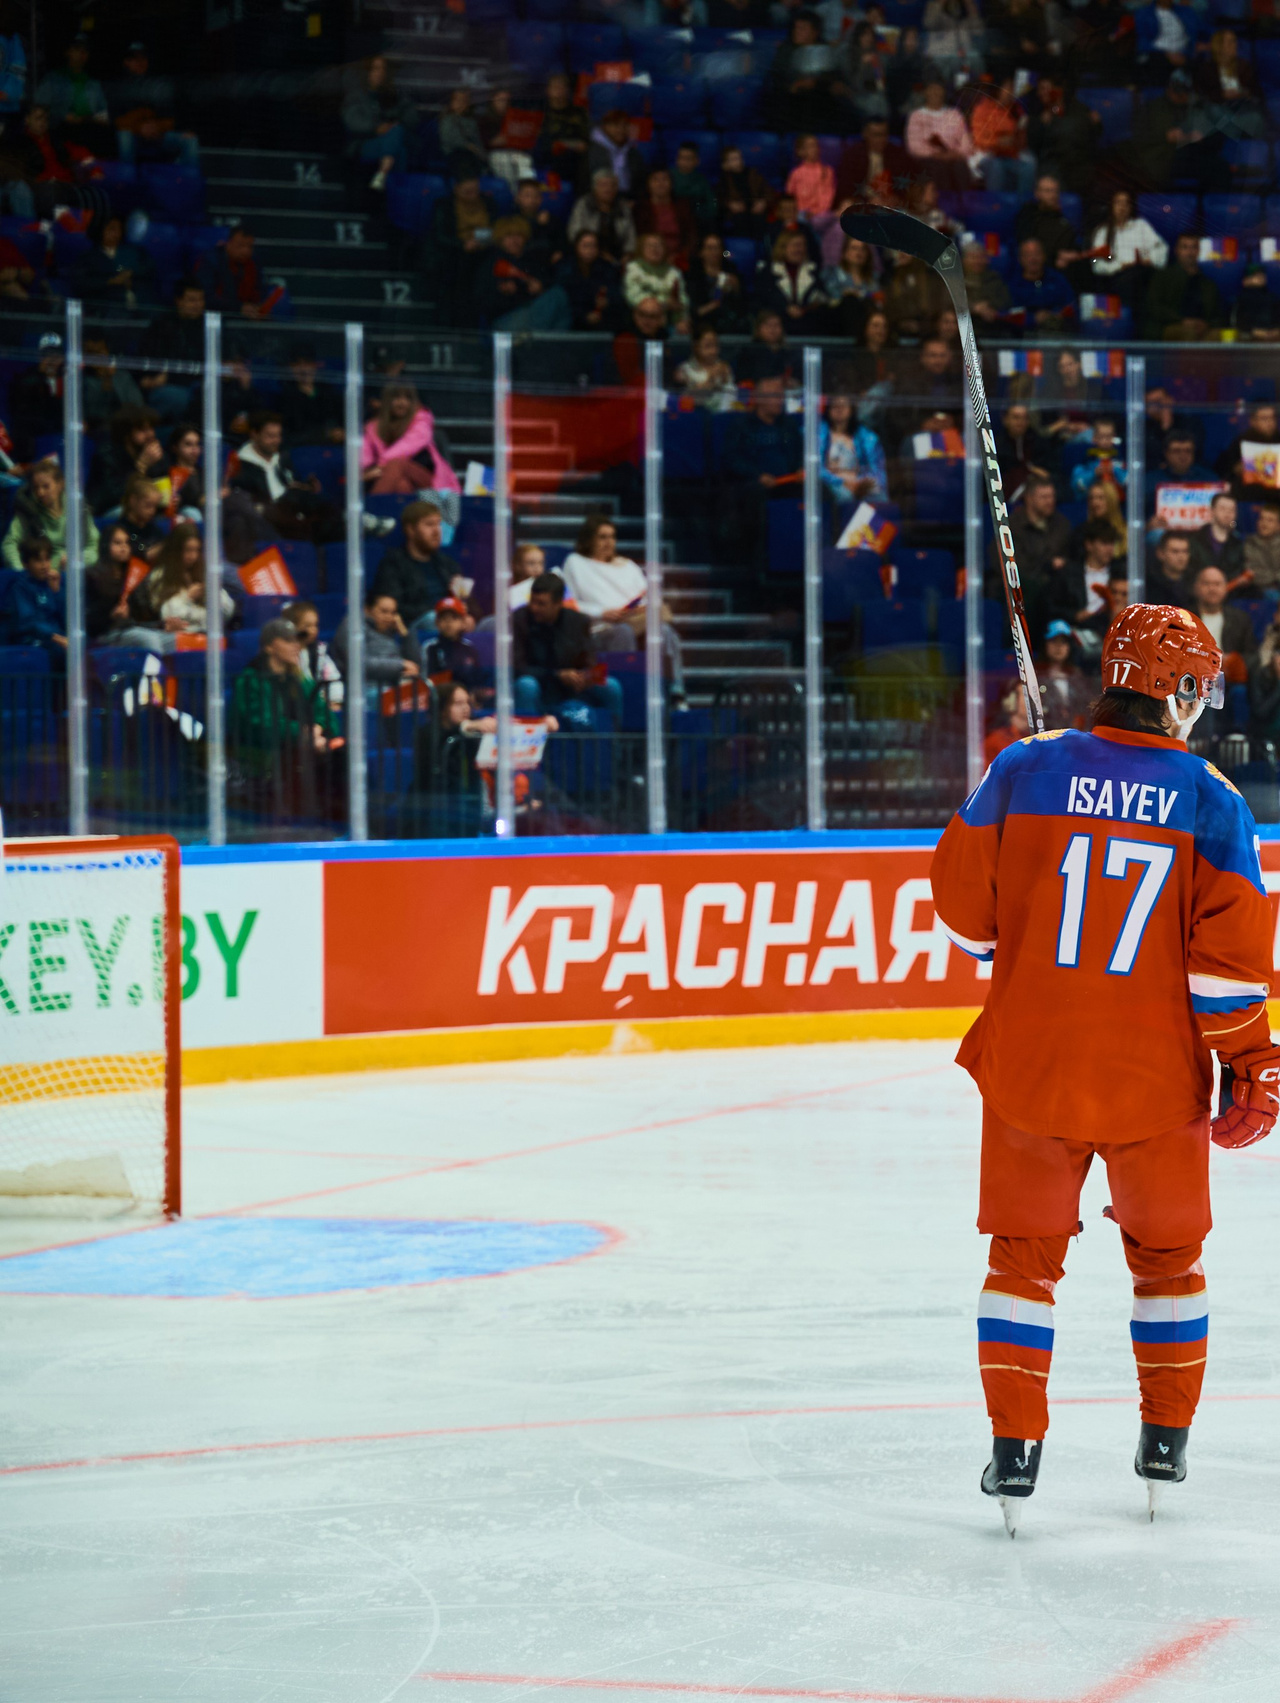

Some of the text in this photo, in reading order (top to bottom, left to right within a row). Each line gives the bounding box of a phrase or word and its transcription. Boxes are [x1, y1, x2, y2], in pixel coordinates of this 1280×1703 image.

[294, 162, 322, 185] 14
[335, 221, 365, 245] 13
[382, 280, 411, 305] 12
[431, 344, 454, 369] 11
[981, 428, 1021, 589] SOYUZ
[1112, 663, 1131, 685] 17
[1067, 775, 1179, 825] ISAYEV
[1055, 832, 1176, 976] 17
[477, 878, 952, 996] КРАСНАЯ
